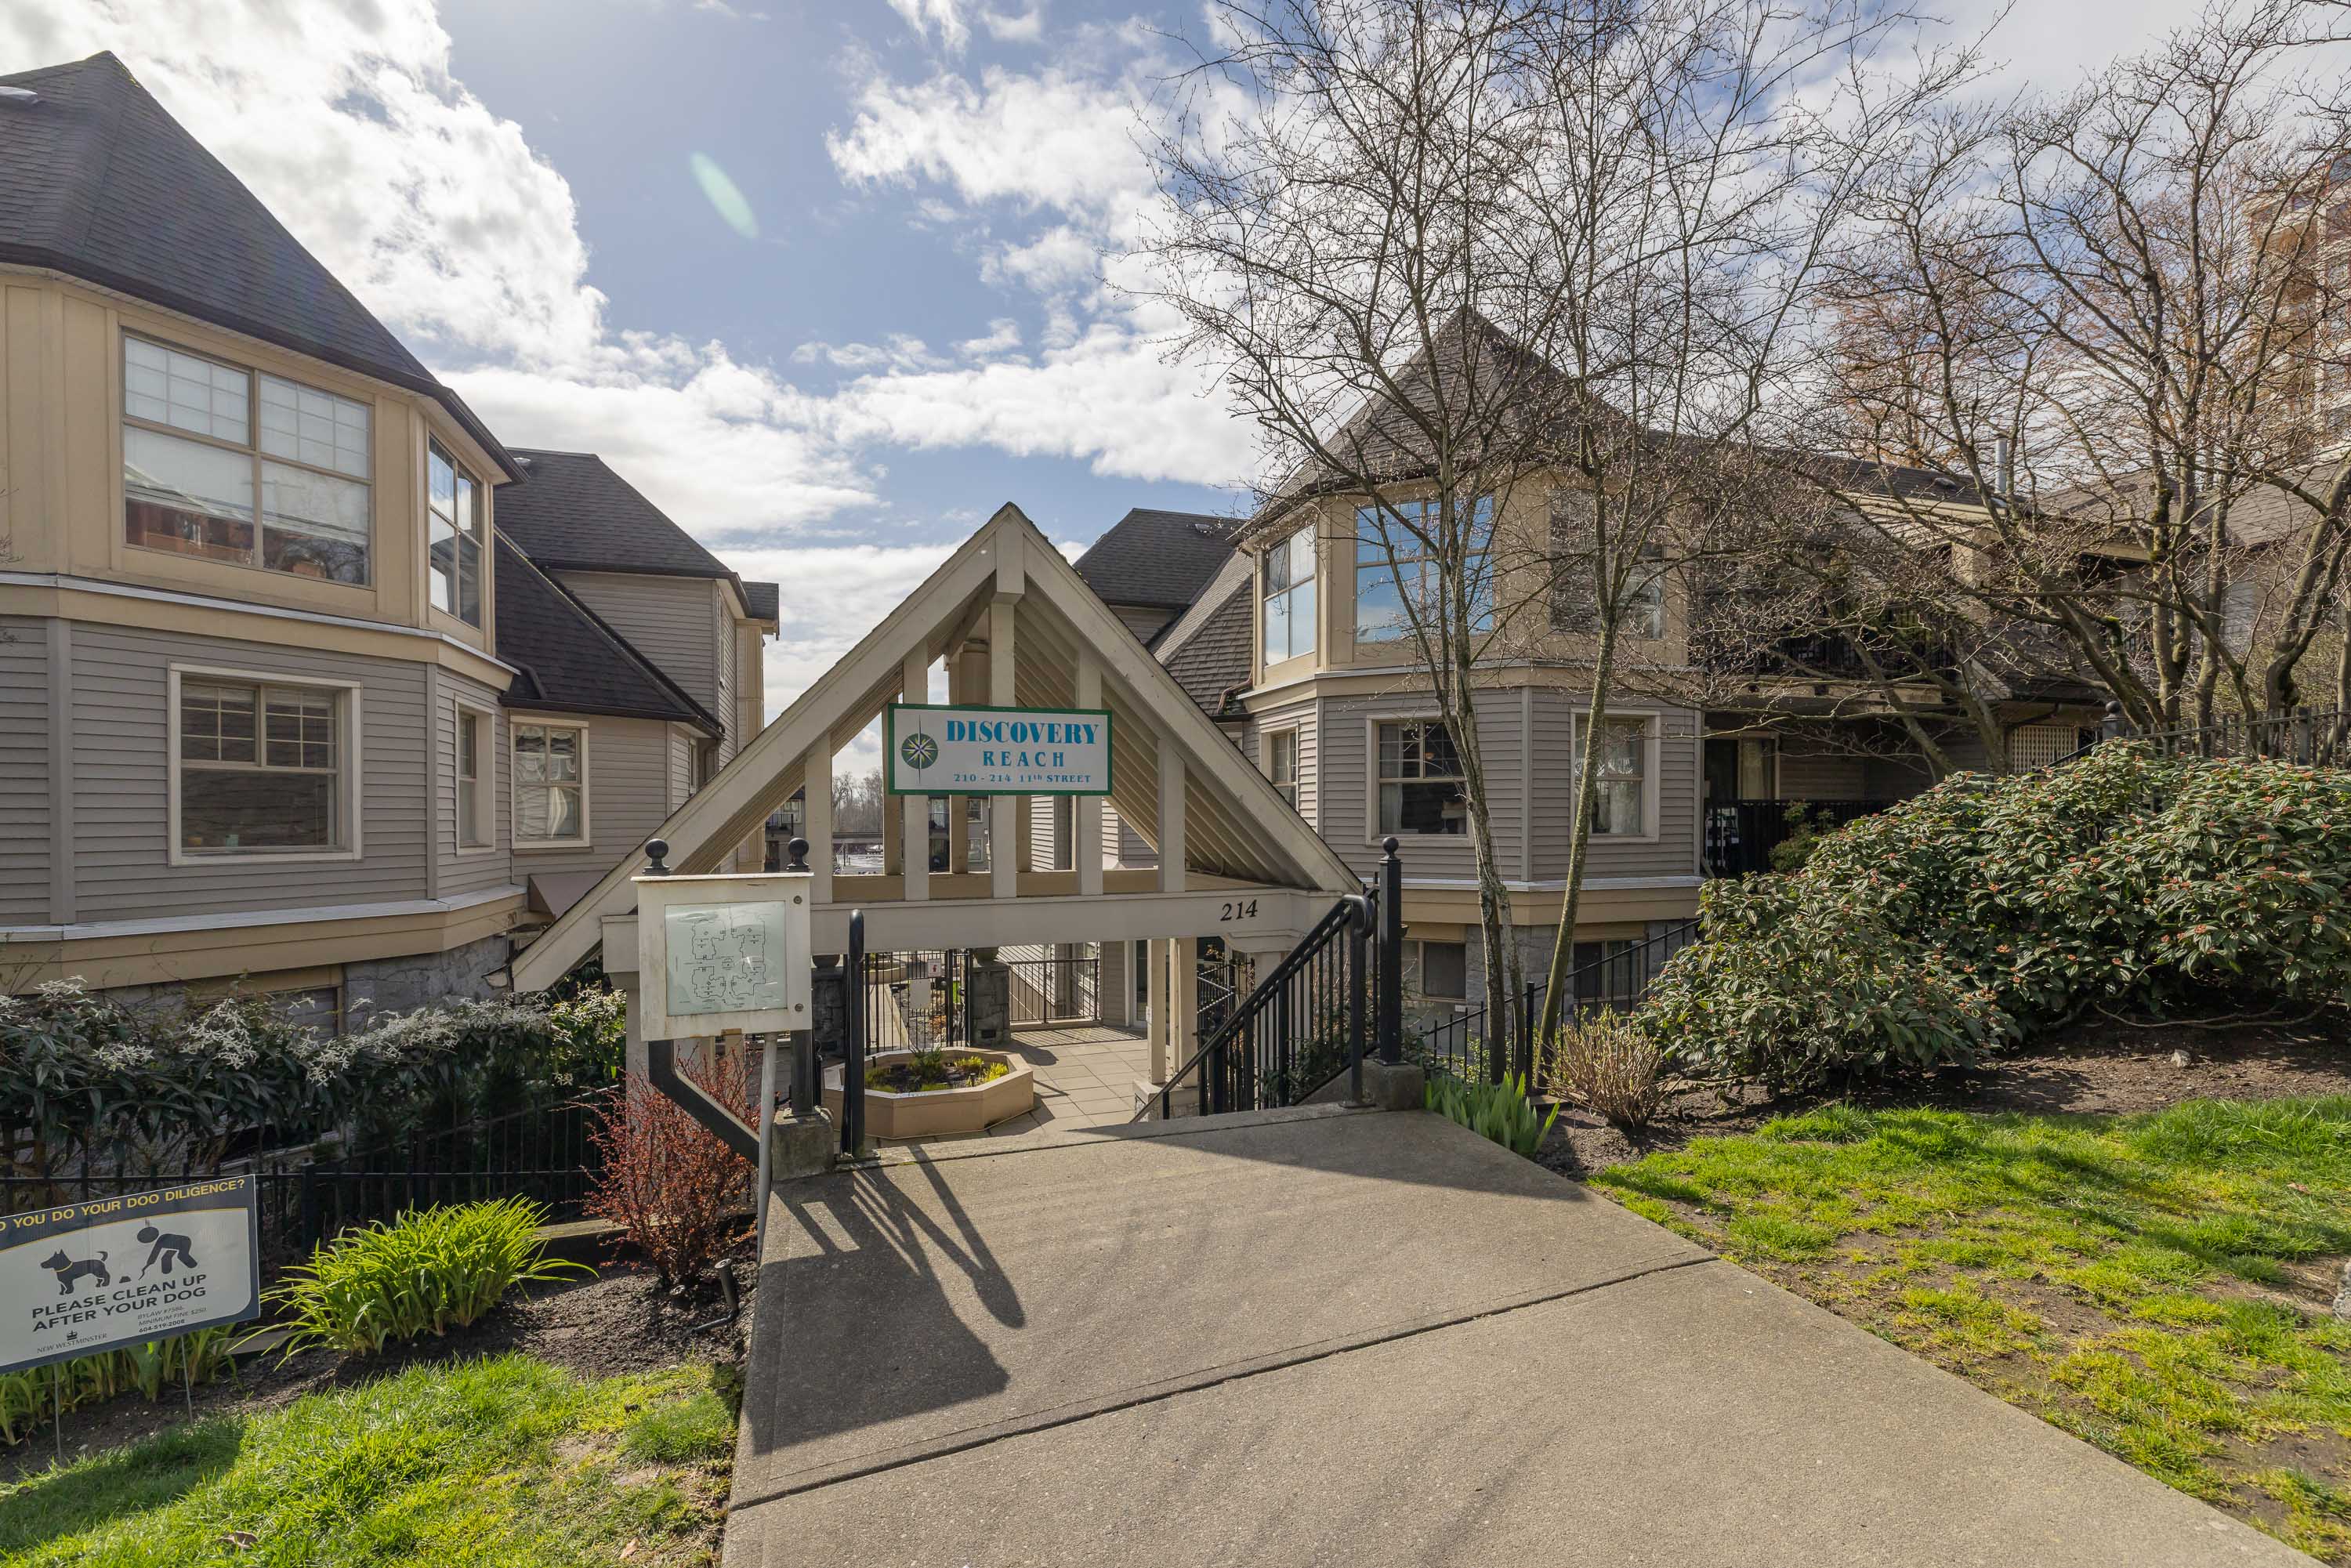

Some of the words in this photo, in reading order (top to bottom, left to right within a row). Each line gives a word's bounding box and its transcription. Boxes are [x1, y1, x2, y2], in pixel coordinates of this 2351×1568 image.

[945, 720, 1099, 744] DISCOVERY
[983, 751, 1064, 767] REACH
[953, 773, 976, 782] 210
[990, 773, 1012, 782] 214
[1020, 773, 1043, 783] 11th
[1046, 773, 1092, 784] STREET
[1220, 899, 1259, 922] 214
[13, 1214, 46, 1229] YOU
[52, 1208, 75, 1222] DO
[81, 1200, 121, 1216] YOUR
[127, 1193, 160, 1208] DOO
[165, 1179, 245, 1201] DILIGENCE?
[32, 1294, 106, 1319] PLEASE
[112, 1280, 176, 1301] CLEAN
[183, 1274, 207, 1287] UP
[33, 1309, 97, 1332] AFTER
[102, 1297, 158, 1316] YOUR
[164, 1287, 206, 1304] DOG
[139, 1315, 173, 1327] MINIMUM
[37, 1345, 54, 1354] NEW
[56, 1333, 107, 1349] WESTMINSTER
